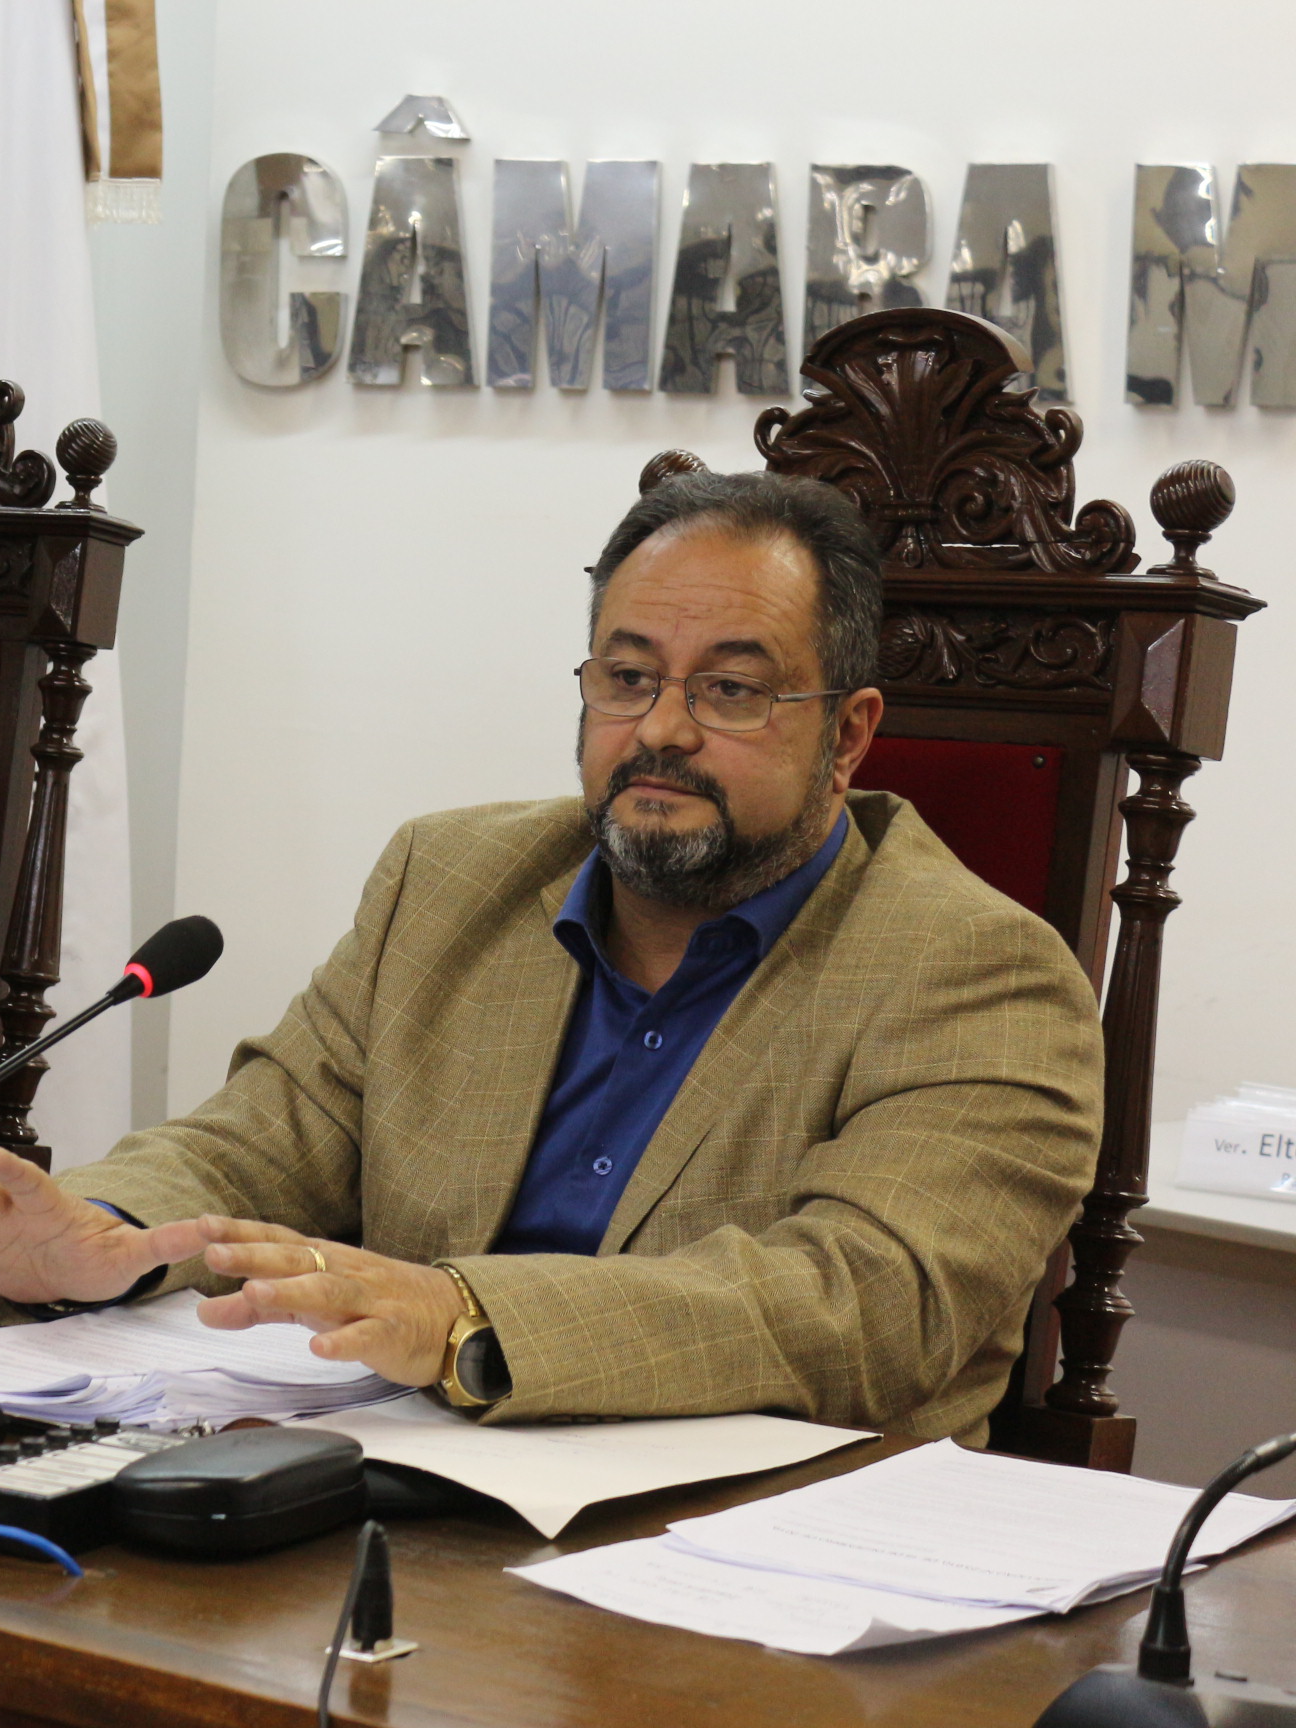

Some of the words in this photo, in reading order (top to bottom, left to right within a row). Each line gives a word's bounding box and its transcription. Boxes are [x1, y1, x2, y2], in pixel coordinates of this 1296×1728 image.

[219, 95, 1072, 404] CÂMARA
[1214, 1138, 1248, 1155] Ver.
[1259, 1133, 1296, 1159] Elt
